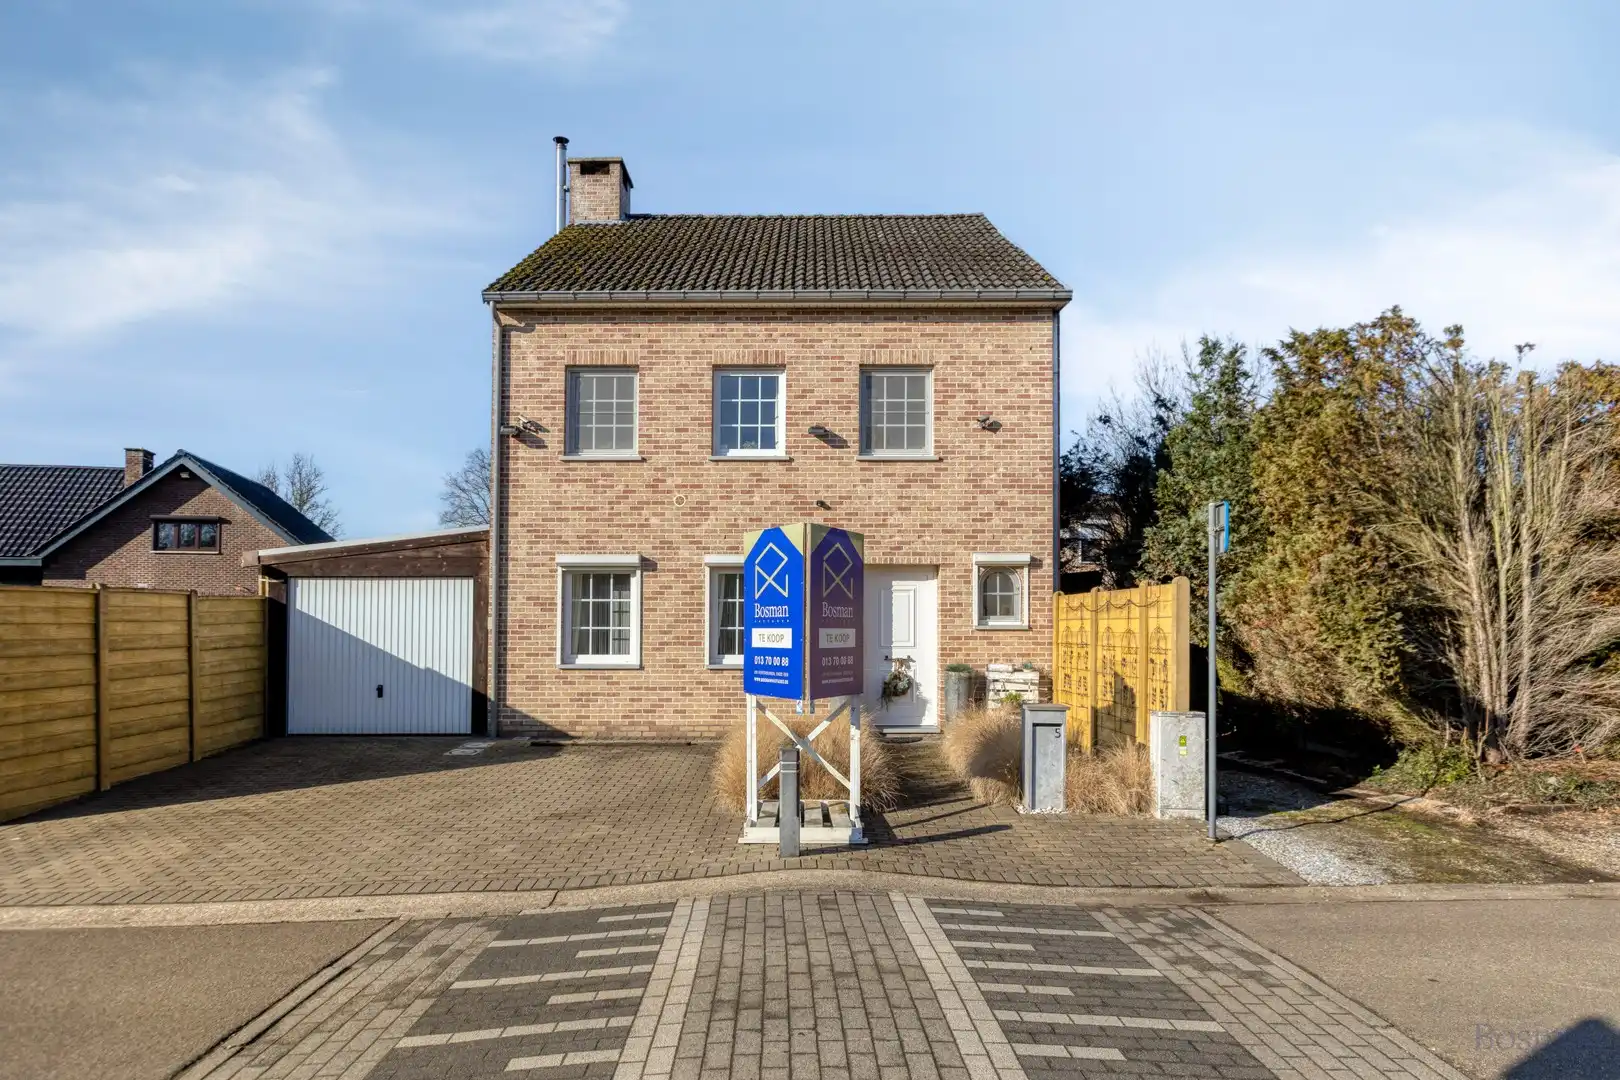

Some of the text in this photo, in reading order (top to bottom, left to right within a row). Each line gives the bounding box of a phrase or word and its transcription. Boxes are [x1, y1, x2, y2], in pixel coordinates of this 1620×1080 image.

[754, 603, 789, 618] Bosman
[822, 601, 854, 618] Bosman
[758, 633, 785, 643] TE KOOP
[826, 633, 834, 643] TE
[754, 655, 765, 665] 013
[765, 656, 773, 666] 70
[773, 656, 781, 667] 00
[1054, 727, 1062, 739] 5
